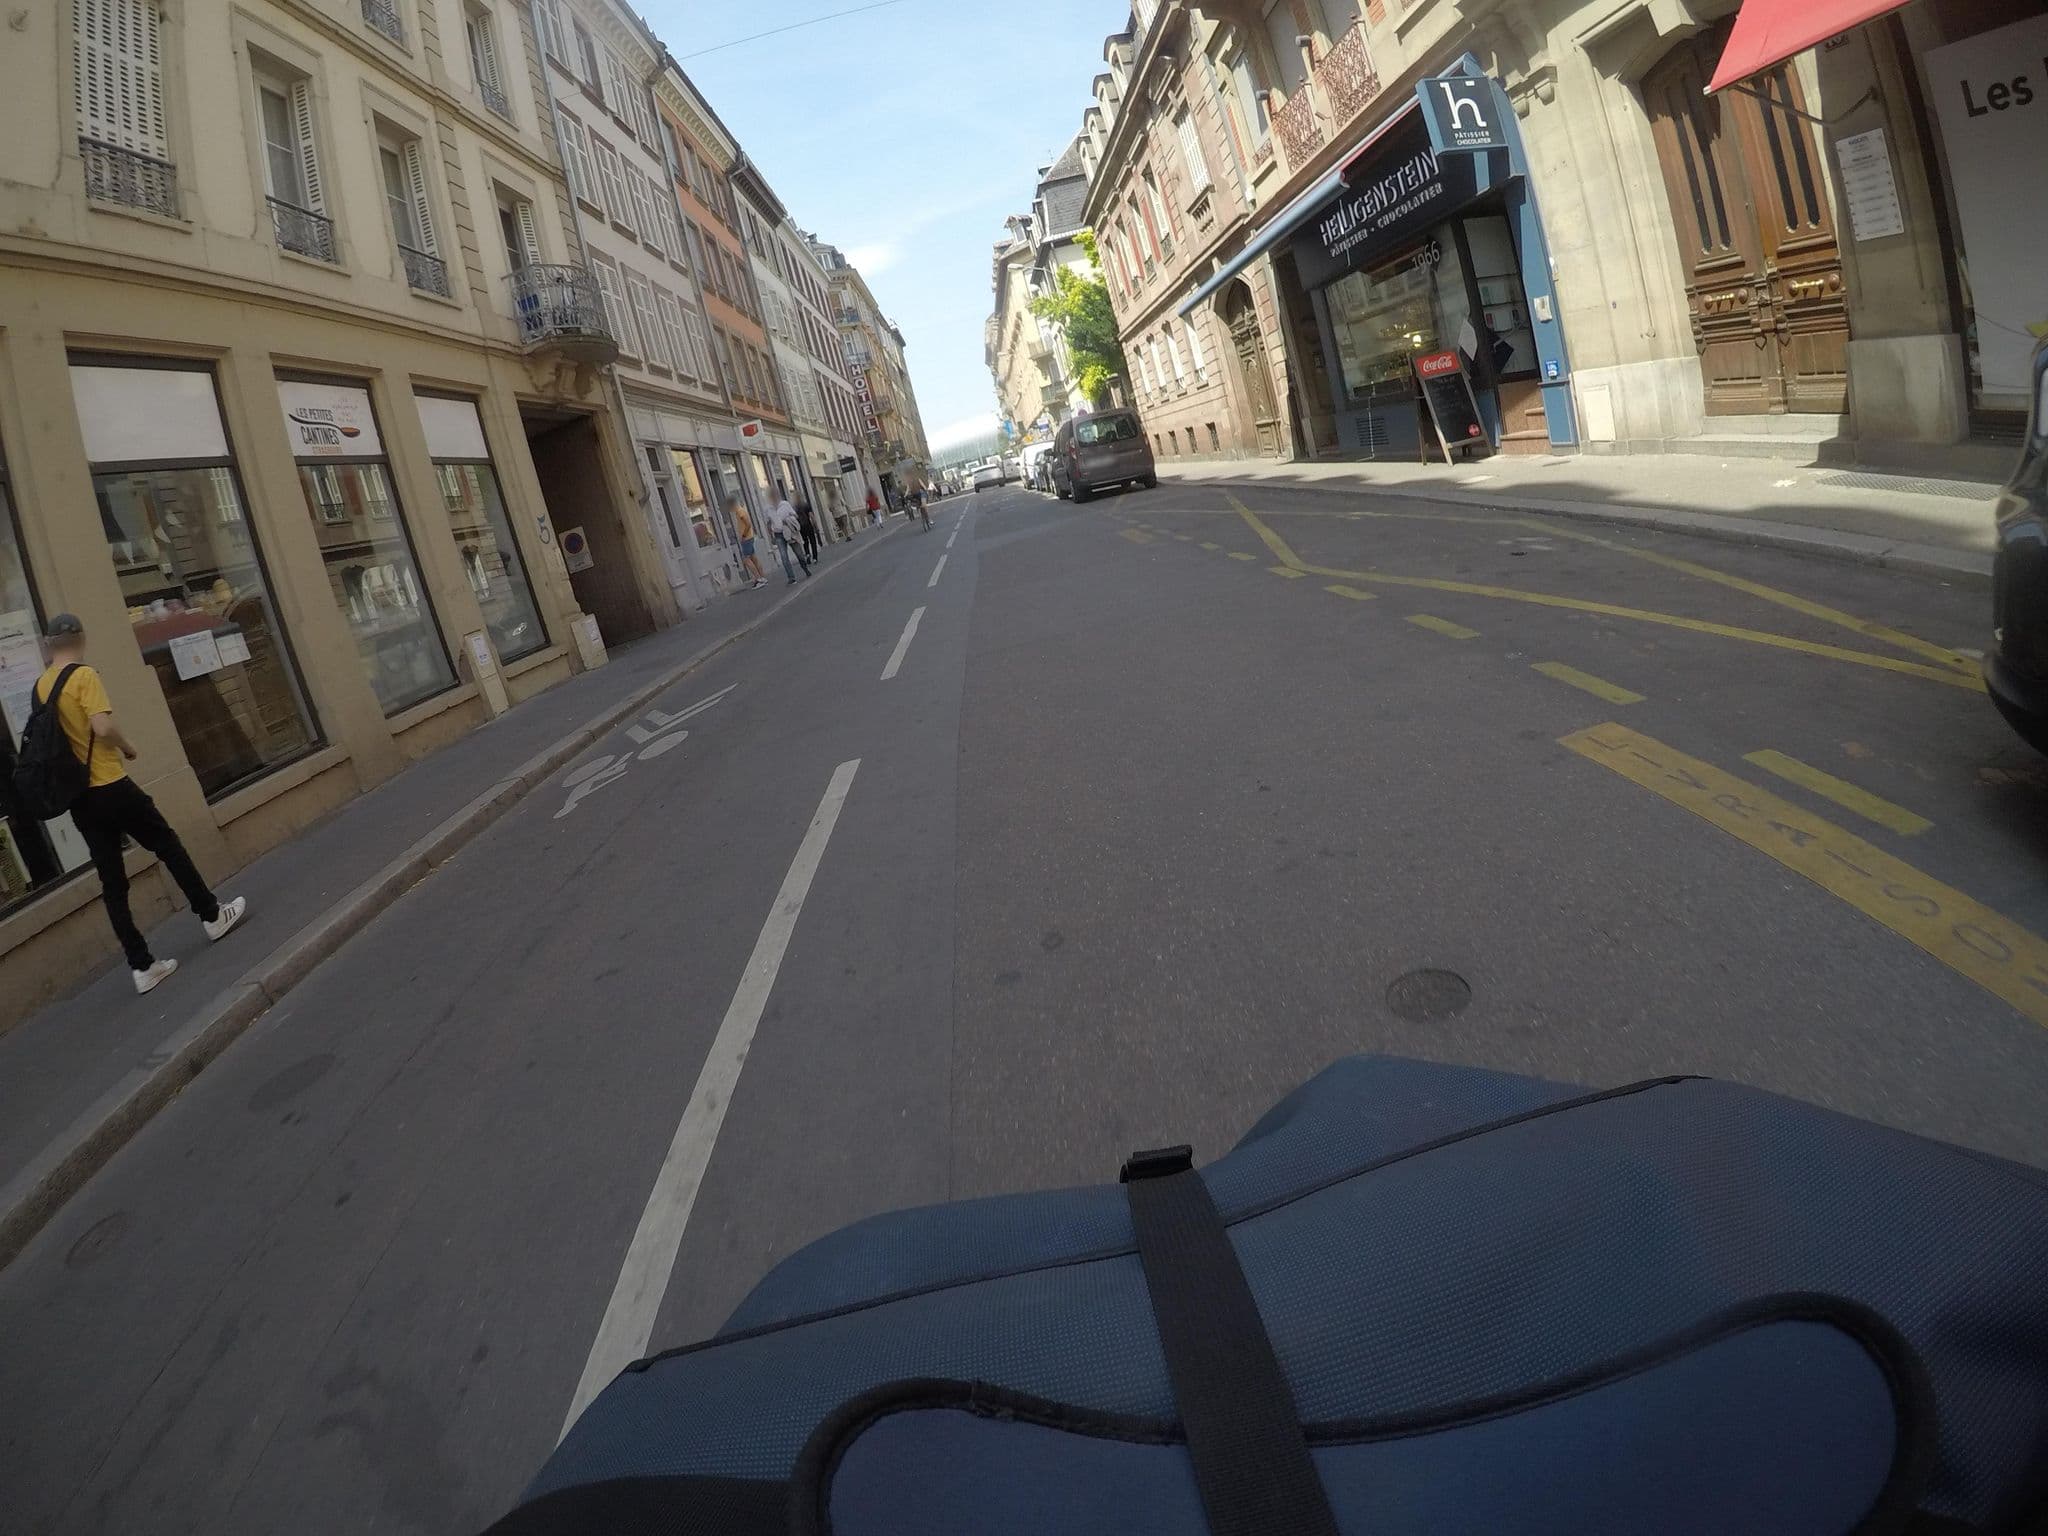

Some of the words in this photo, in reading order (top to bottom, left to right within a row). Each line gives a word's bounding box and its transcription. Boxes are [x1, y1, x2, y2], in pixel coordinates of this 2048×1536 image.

[1439, 81, 1487, 129] h
[1960, 76, 2034, 118] Les
[1456, 137, 1492, 146] CHOCOLATIER
[1319, 145, 1440, 247] HEILIGENSTEIN
[1377, 182, 1443, 228] CHOCOLATIER
[1411, 240, 1440, 271] 1966
[1423, 356, 1453, 372] Coca-Cola
[296, 407, 309, 419] LES
[309, 408, 333, 422] PETITES
[851, 364, 876, 430] HOTEL
[300, 426, 340, 445] CANTINES
